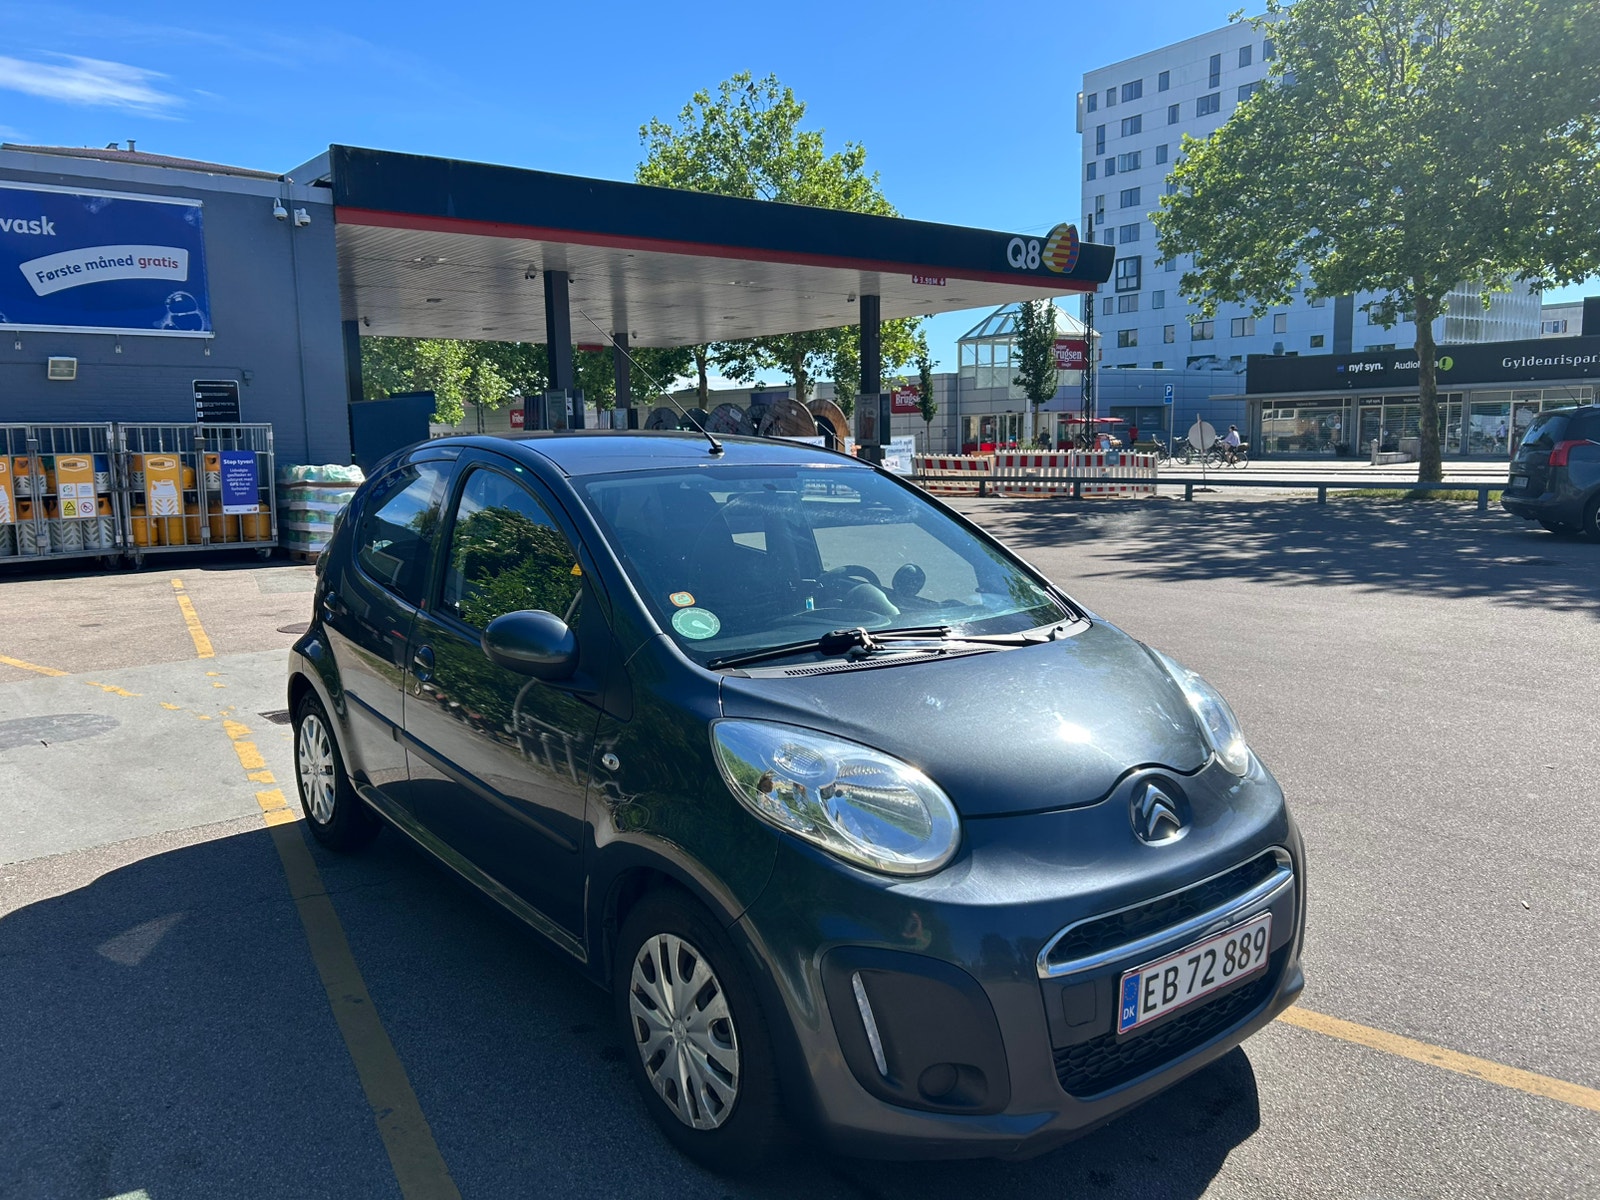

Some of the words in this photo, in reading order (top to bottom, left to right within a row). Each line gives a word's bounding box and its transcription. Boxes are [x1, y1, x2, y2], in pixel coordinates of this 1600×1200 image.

[1006, 237, 1040, 270] Q8
[35, 263, 82, 284] Første
[85, 254, 134, 272] måned
[138, 256, 179, 270] gratis
[1348, 362, 1364, 373] nyt
[1364, 361, 1384, 372] syn.
[1502, 353, 1600, 369] Gyldenrispar
[1166, 385, 1172, 396] P
[1142, 966, 1179, 1014] EB
[1186, 948, 1217, 994] 72
[1222, 926, 1266, 977] 889
[1123, 1004, 1136, 1020] DK
